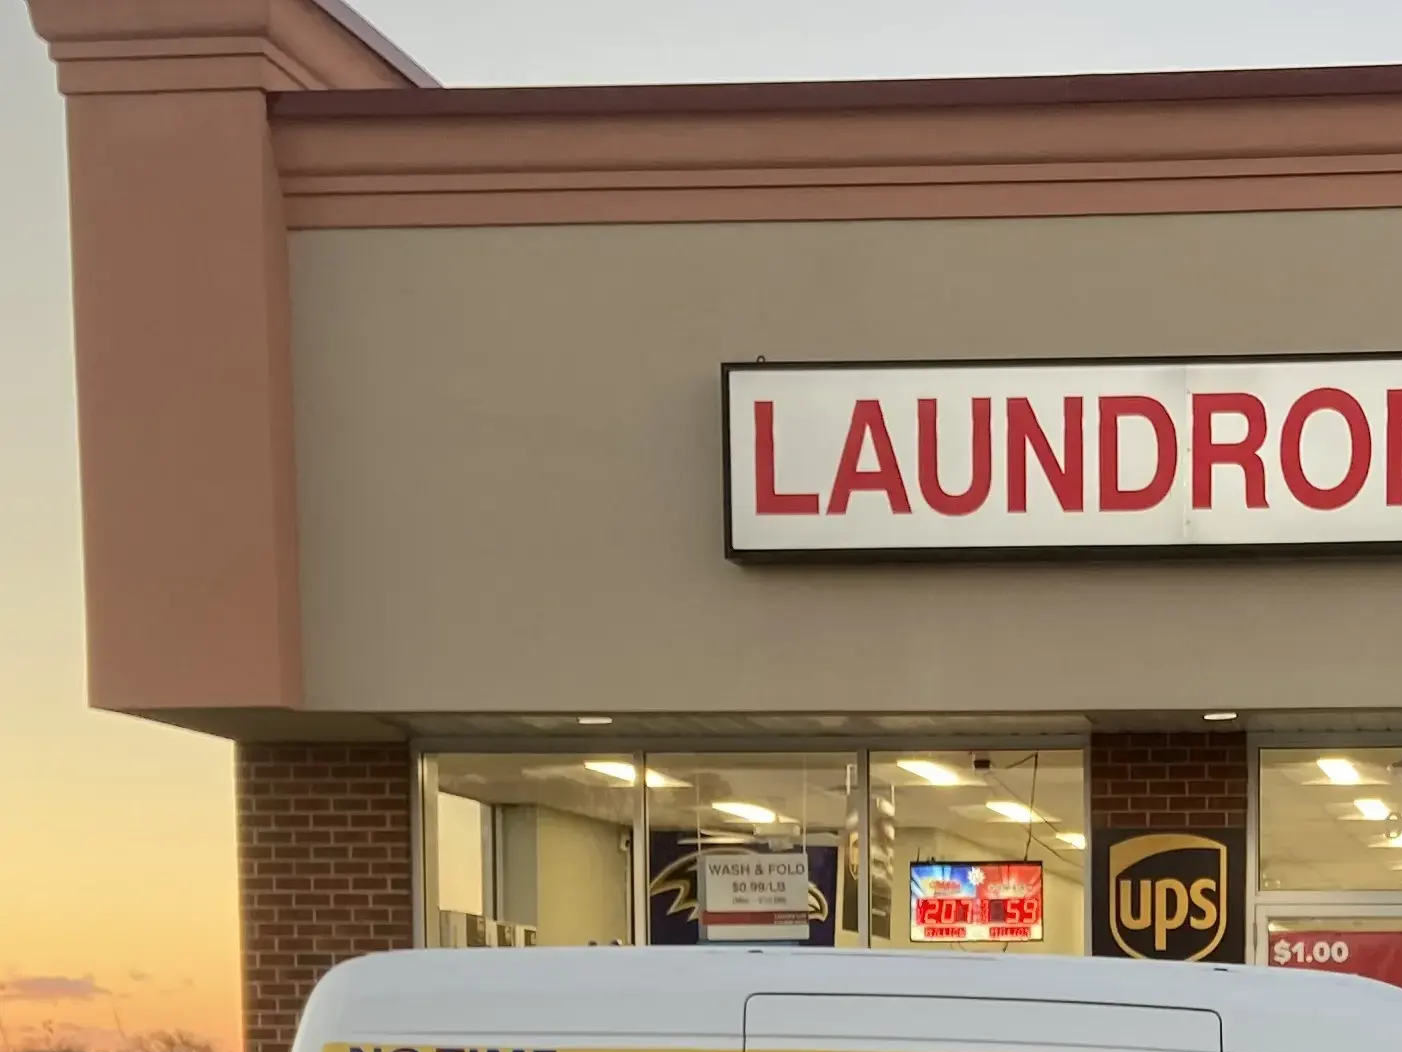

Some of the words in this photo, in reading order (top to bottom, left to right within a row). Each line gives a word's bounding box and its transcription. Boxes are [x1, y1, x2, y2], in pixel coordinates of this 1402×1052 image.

[708, 863, 750, 876] WASH
[754, 863, 764, 876] &
[768, 863, 805, 876] FOLD
[1119, 877, 1219, 951] ups
[1273, 939, 1350, 965] $1.00
